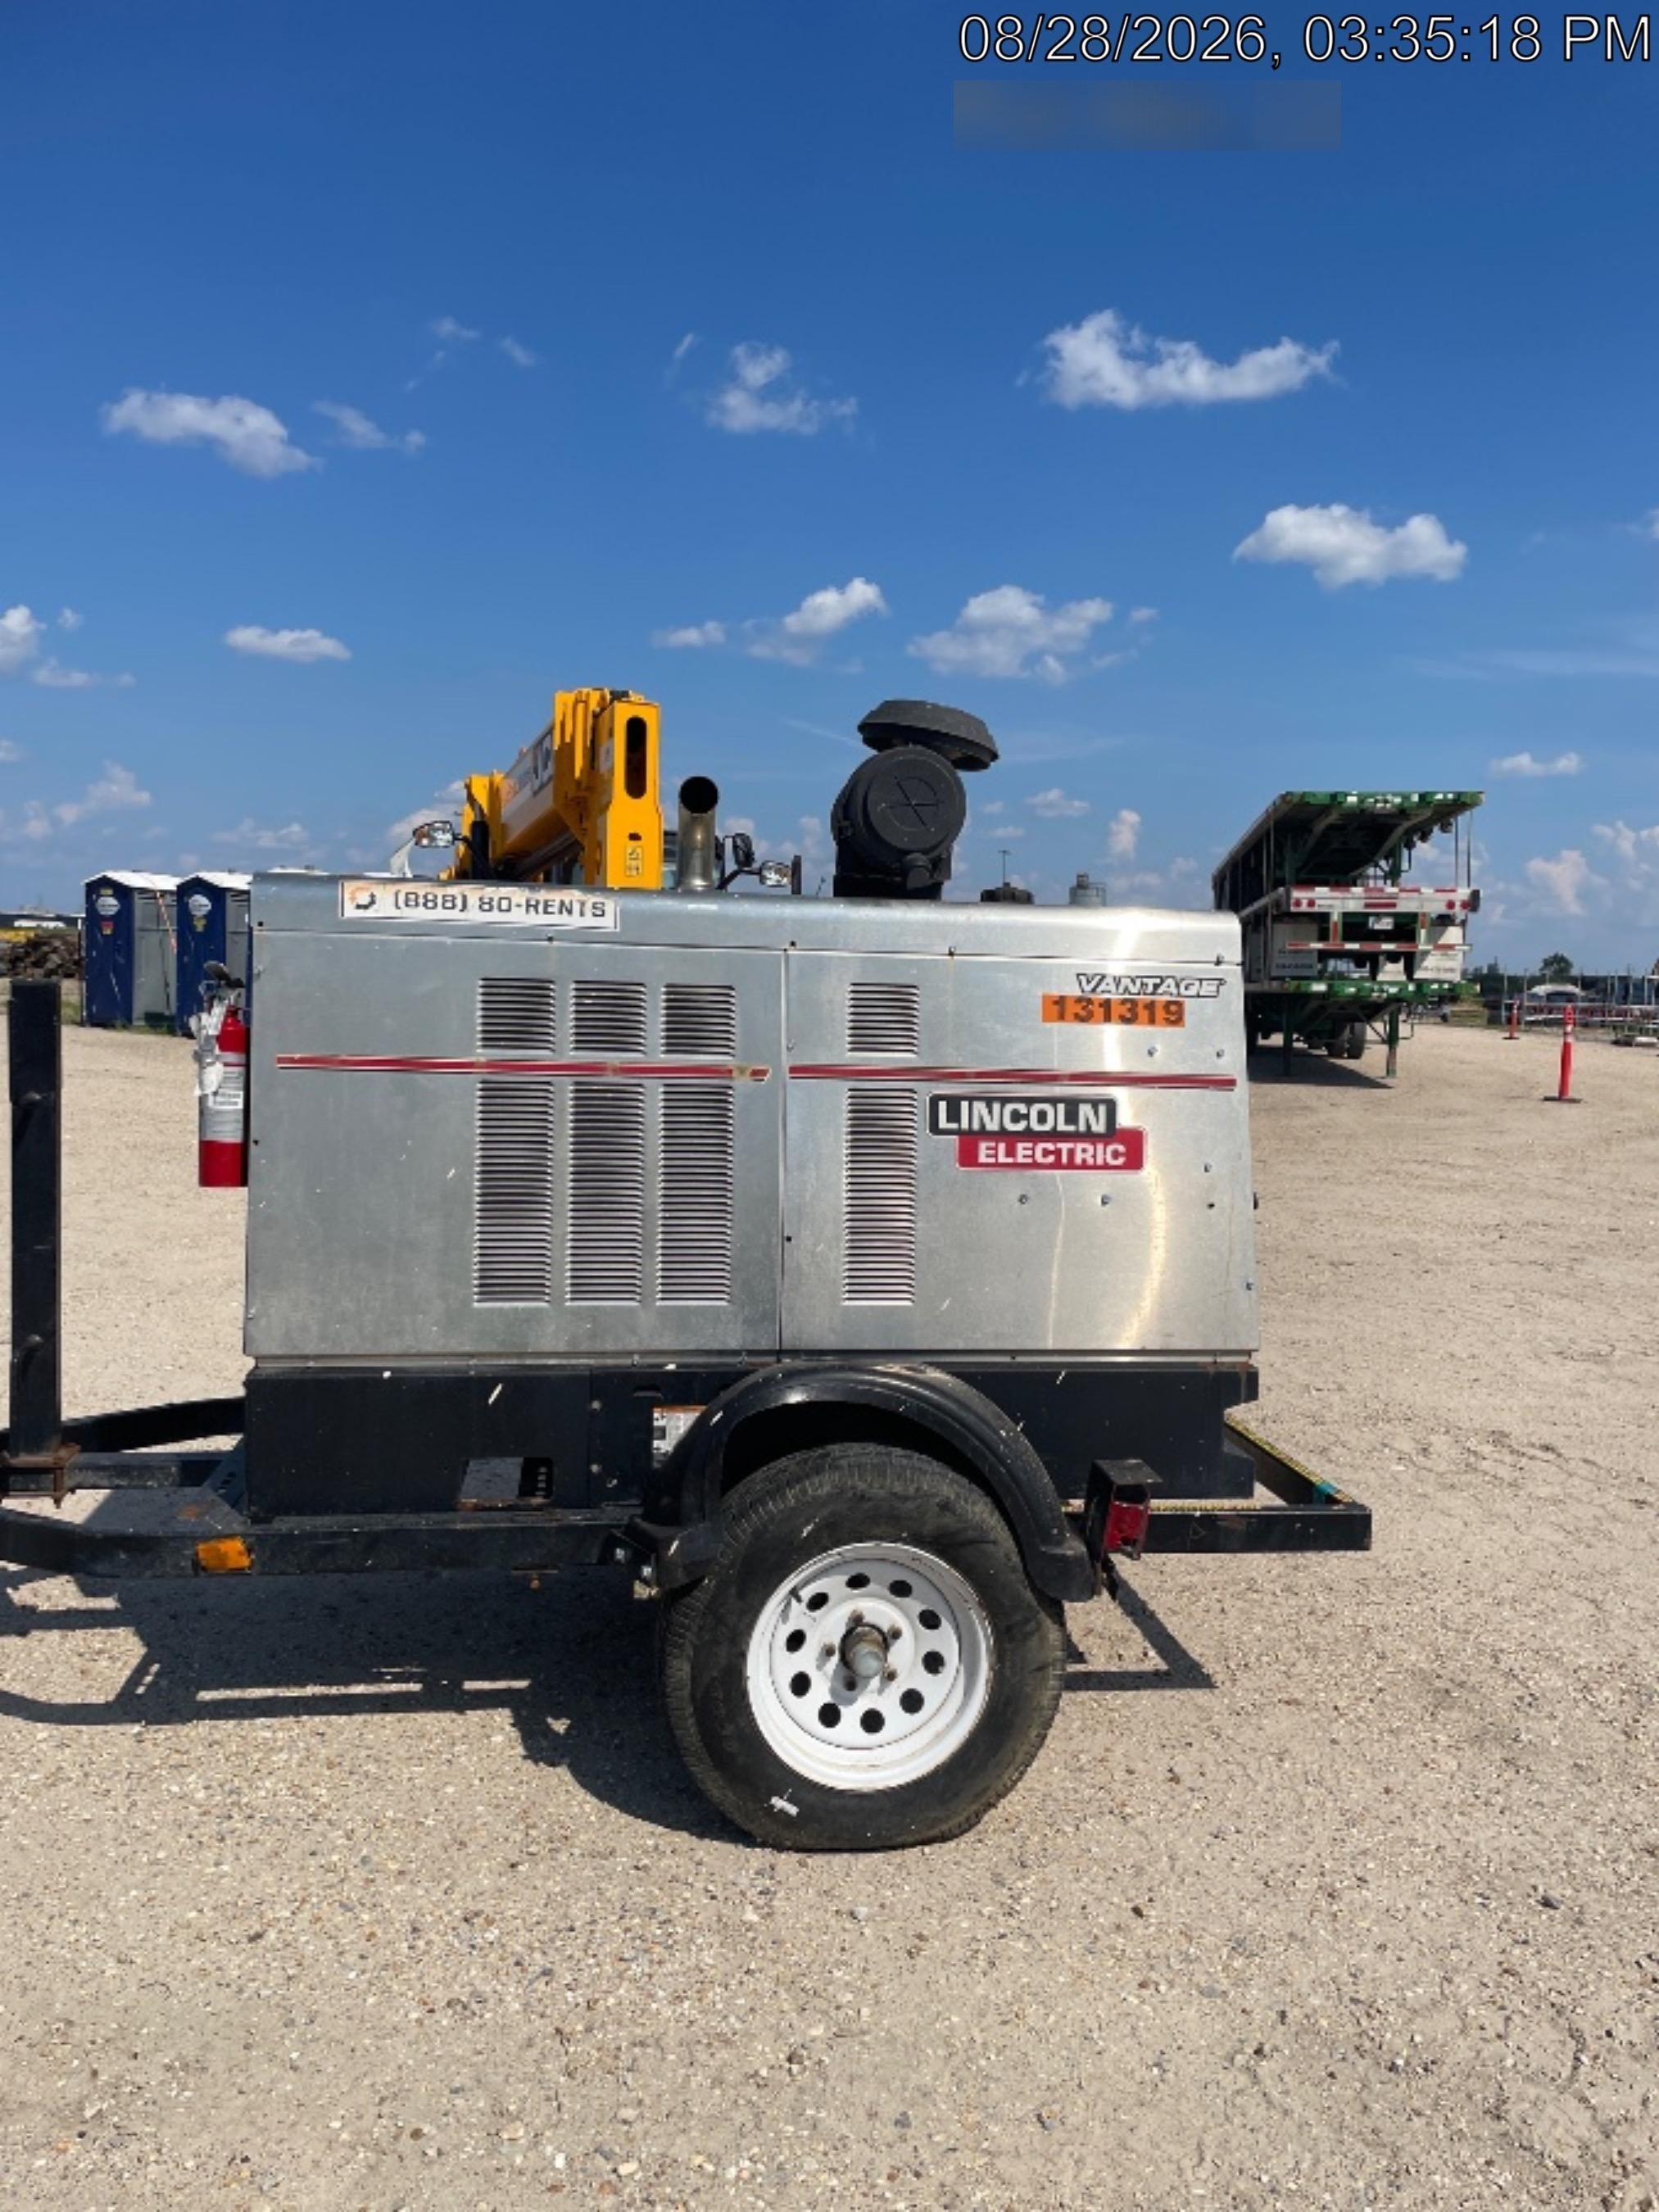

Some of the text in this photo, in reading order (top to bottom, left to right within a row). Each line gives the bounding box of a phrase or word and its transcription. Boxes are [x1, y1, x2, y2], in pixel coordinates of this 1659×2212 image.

[395, 890, 605, 918] (888) 80-RENTS
[1076, 972, 1223, 999] VANTAGE
[1051, 995, 1185, 1026] 131319
[937, 1099, 1108, 1135] LINCOLN
[977, 1141, 1127, 1167] ELECTRIC
